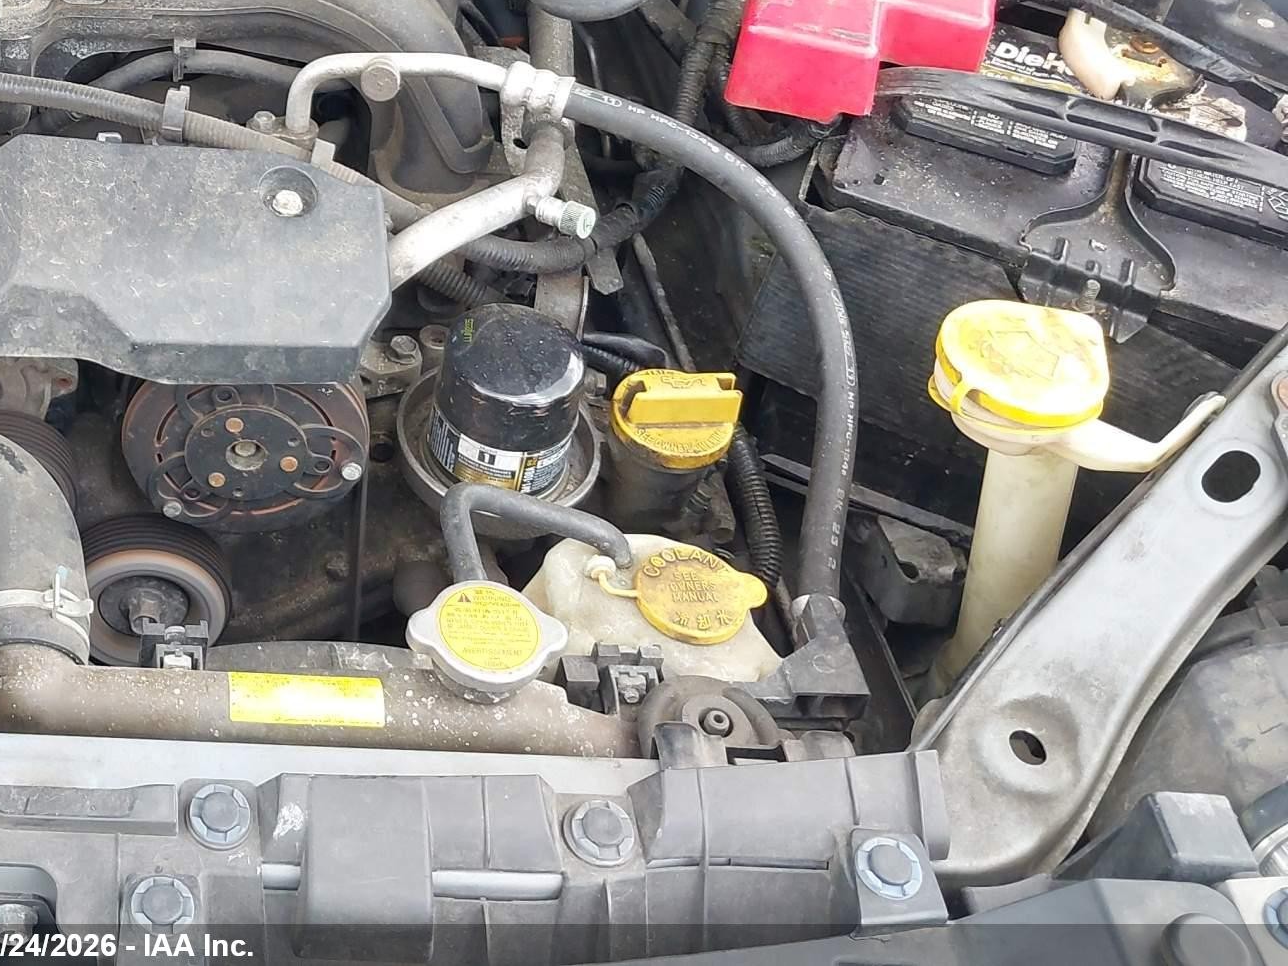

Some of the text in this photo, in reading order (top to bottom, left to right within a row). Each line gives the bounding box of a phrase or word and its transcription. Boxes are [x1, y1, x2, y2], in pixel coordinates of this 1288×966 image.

[643, 548, 730, 577] COOLANT
[673, 572, 699, 582] SEE
[671, 592, 719, 603] MANUAL
